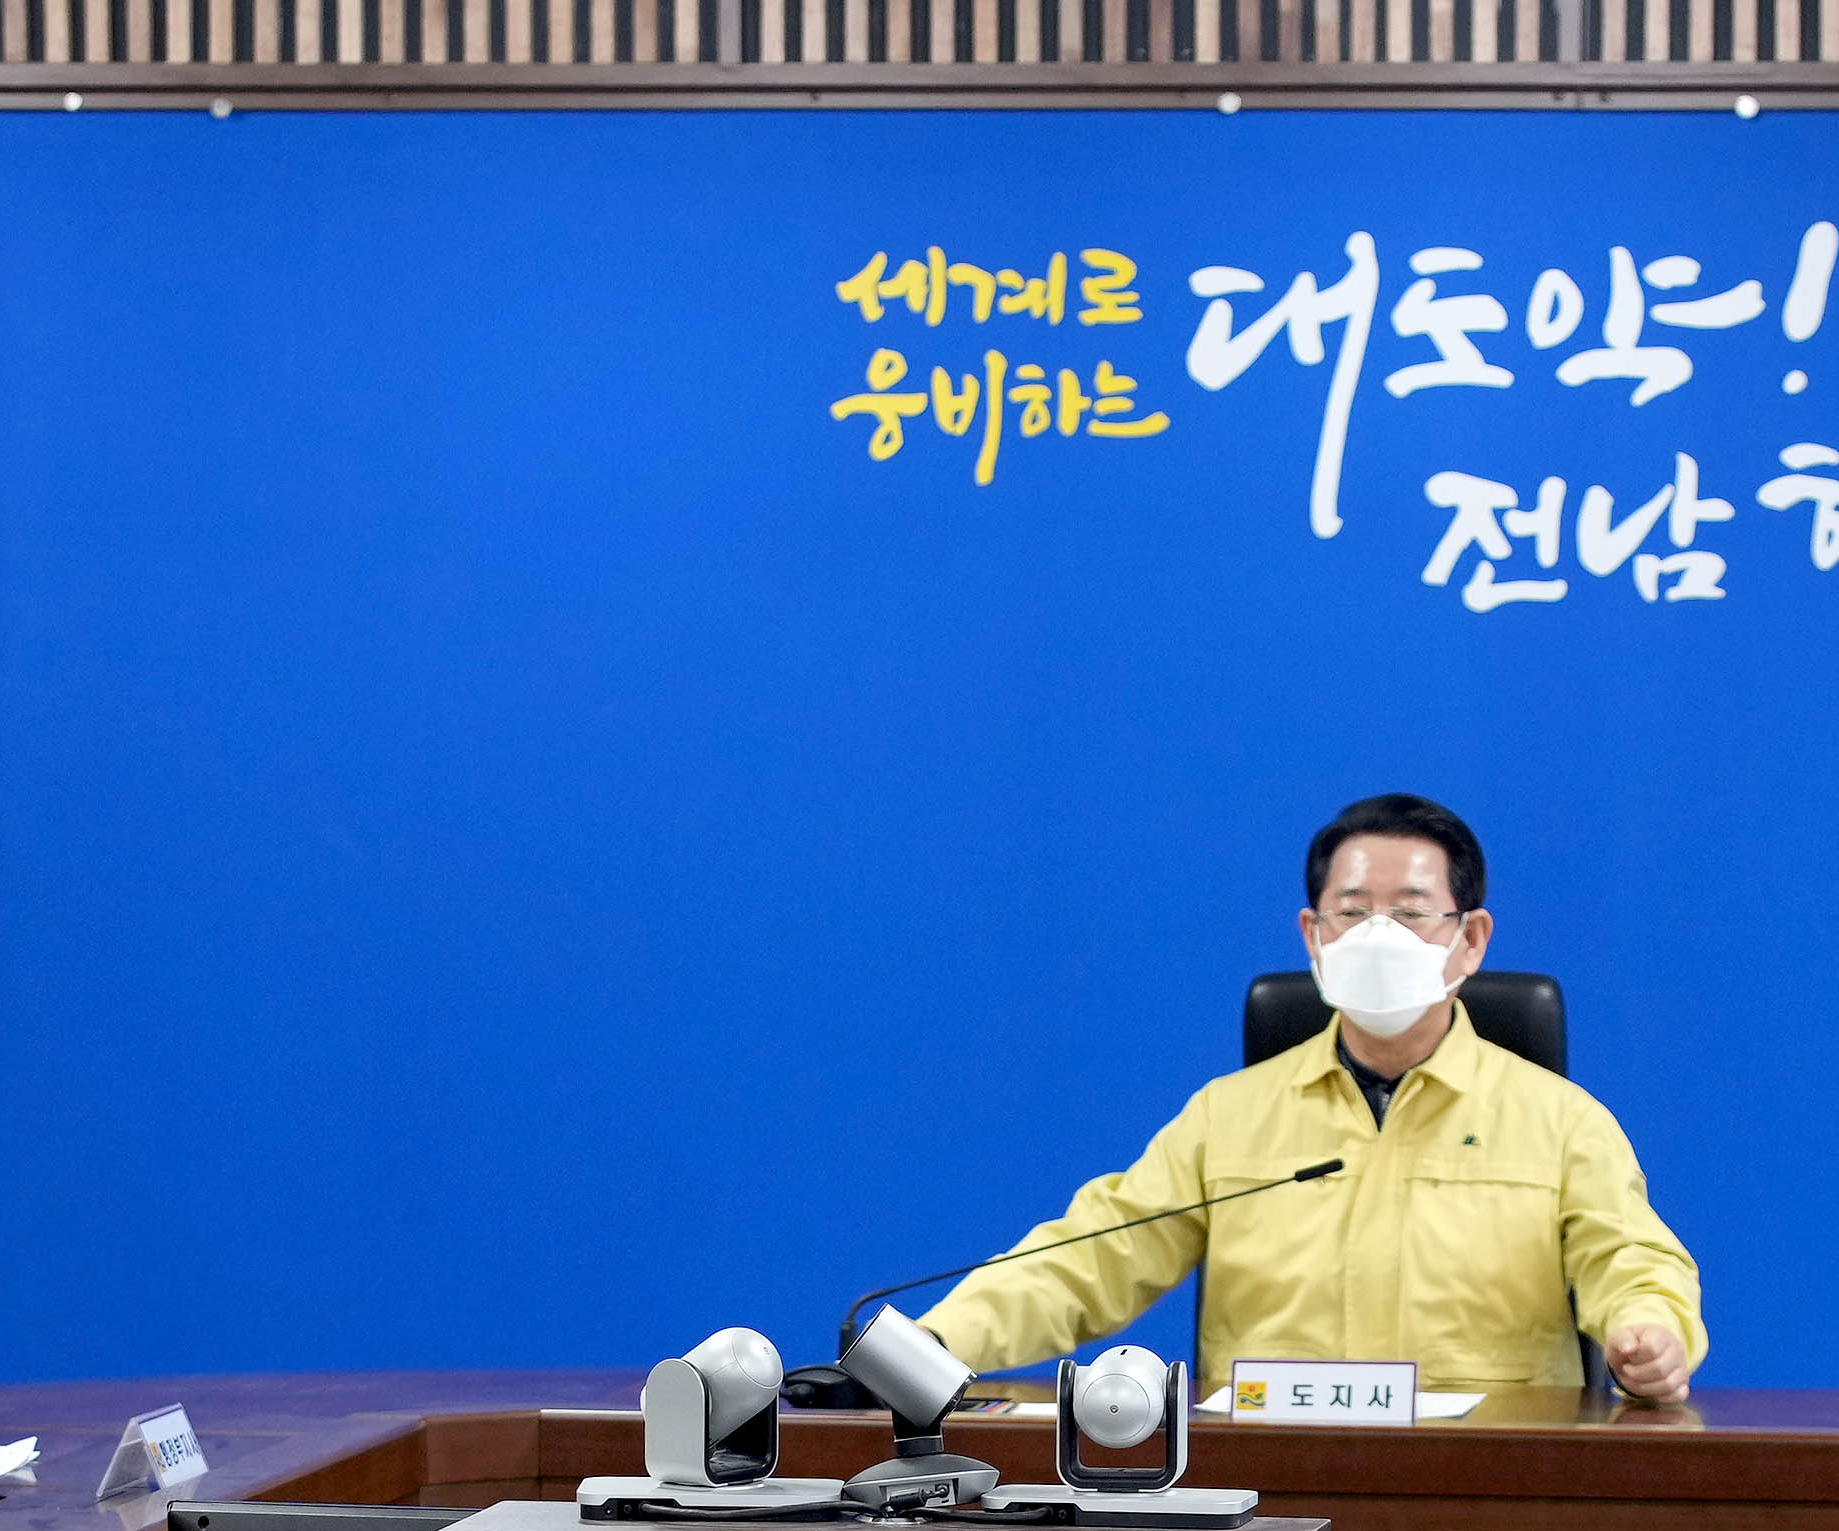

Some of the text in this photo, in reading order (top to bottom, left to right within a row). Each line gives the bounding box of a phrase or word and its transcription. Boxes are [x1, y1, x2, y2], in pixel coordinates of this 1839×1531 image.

[835, 245, 1144, 326] 세계로
[830, 348, 1170, 486] 웅비하는
[1186, 221, 1839, 538] 대도약!
[1423, 452, 1735, 612] 전남
[1291, 1384, 1393, 1409] 도지사
